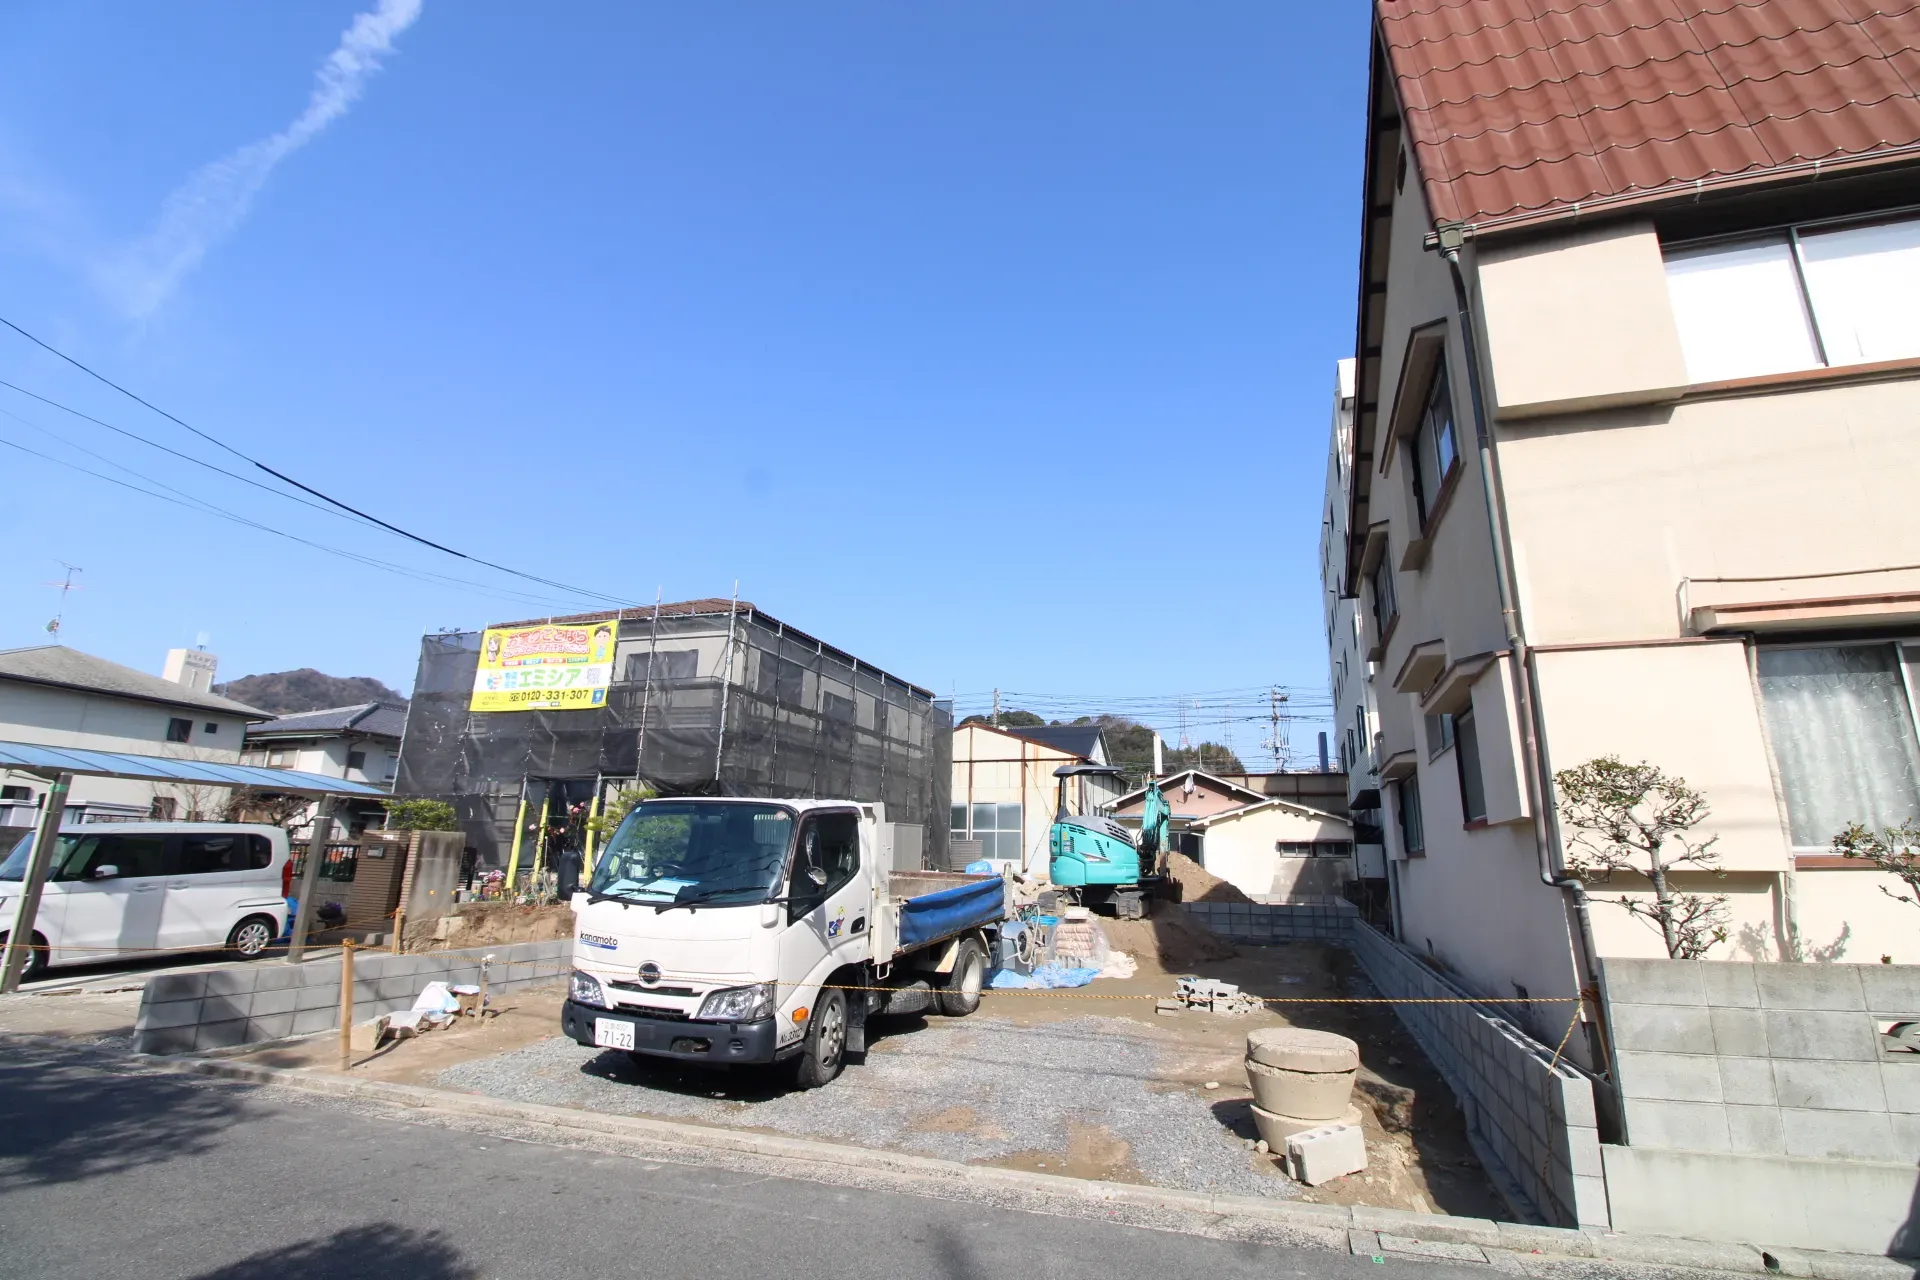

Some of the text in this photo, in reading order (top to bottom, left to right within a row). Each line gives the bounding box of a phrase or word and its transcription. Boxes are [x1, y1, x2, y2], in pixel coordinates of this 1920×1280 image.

[519, 668, 582, 688] エミシア
[521, 689, 589, 701] 0120-331-307
[580, 930, 618, 946] kanamoto
[603, 1030, 632, 1048] 71-22
